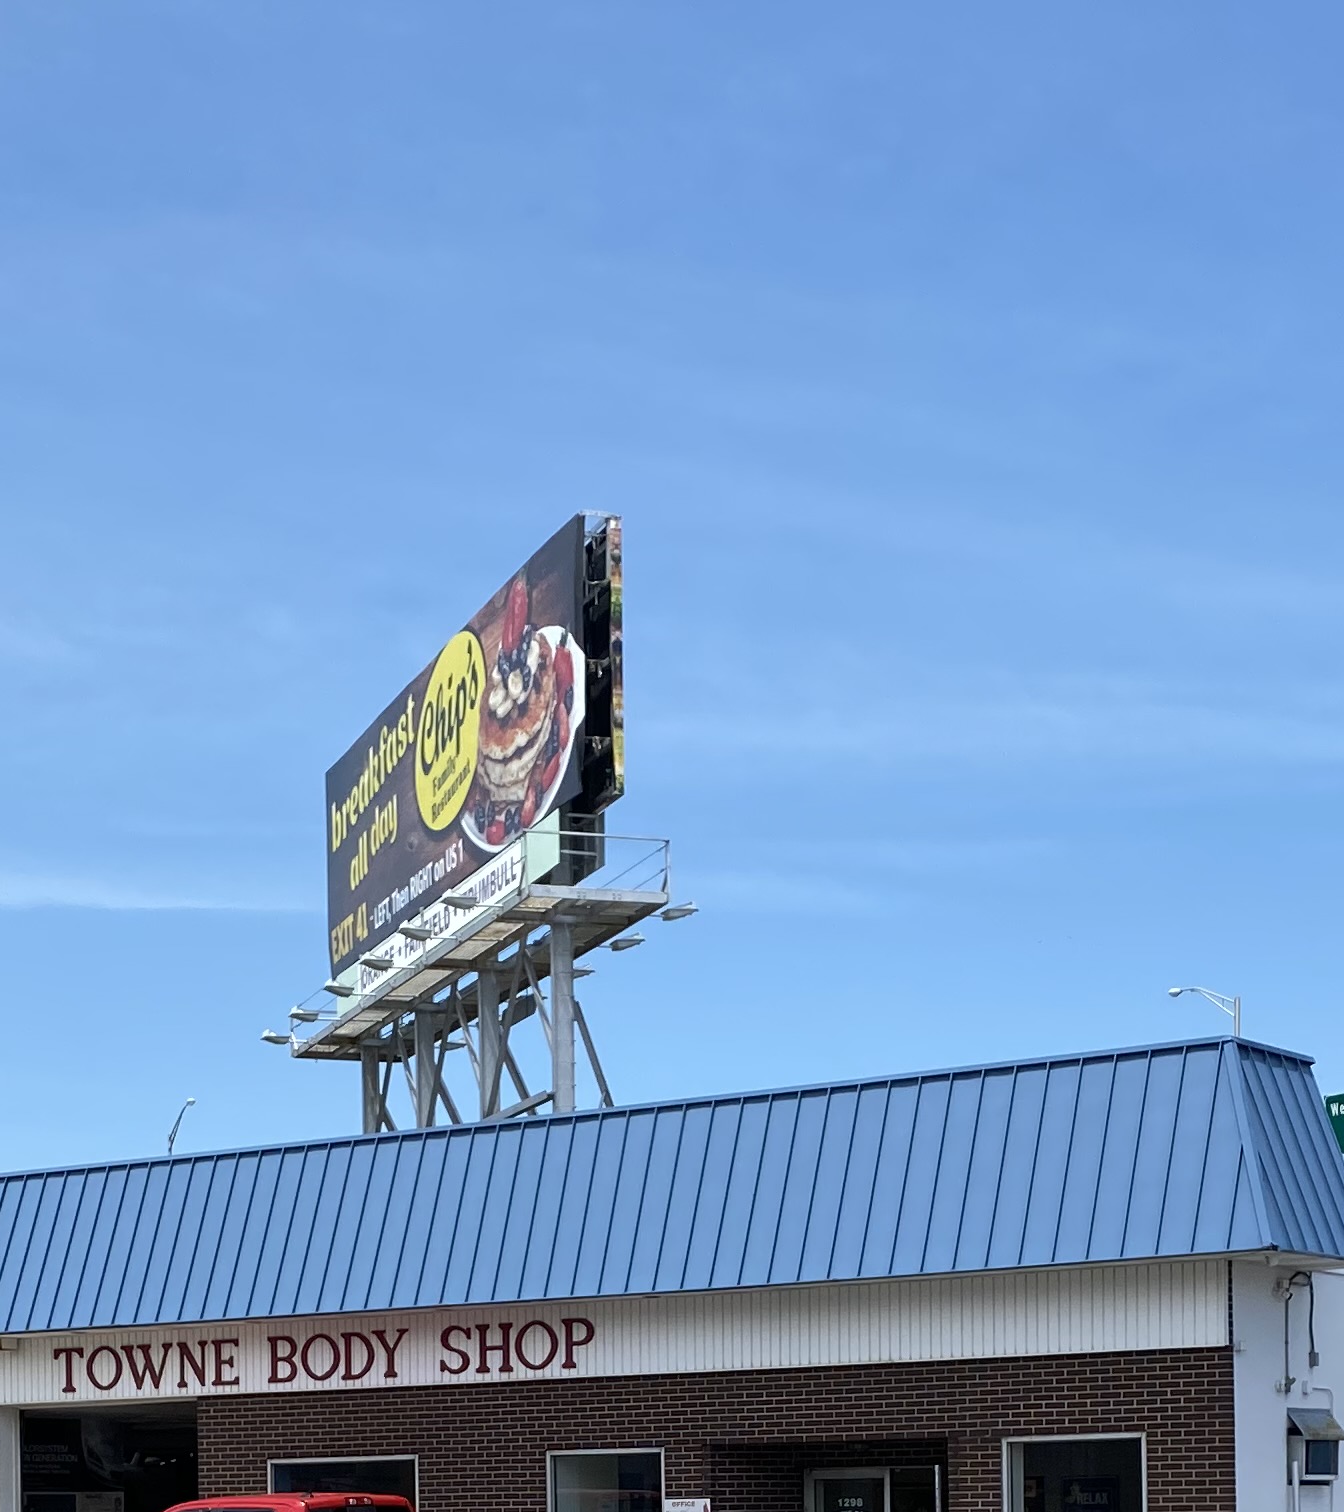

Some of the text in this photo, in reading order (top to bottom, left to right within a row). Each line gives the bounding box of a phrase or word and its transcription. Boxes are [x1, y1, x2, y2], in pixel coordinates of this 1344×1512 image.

[420, 639, 478, 775] Chip's
[331, 693, 416, 852] breakfast
[432, 755, 456, 798] Family
[349, 793, 398, 891] all day
[331, 913, 354, 965] EXIT
[355, 902, 368, 941] 41
[391, 887, 409, 915] Then
[409, 860, 433, 900] RIGHT
[433, 857, 445, 882] on
[445, 844, 458, 873] US
[458, 837, 464, 863] 1
[52, 1316, 595, 1394] TOWNE BODY SHOP
[837, 1497, 864, 1508] 1298
[1076, 1491, 1109, 1505] RELAX
